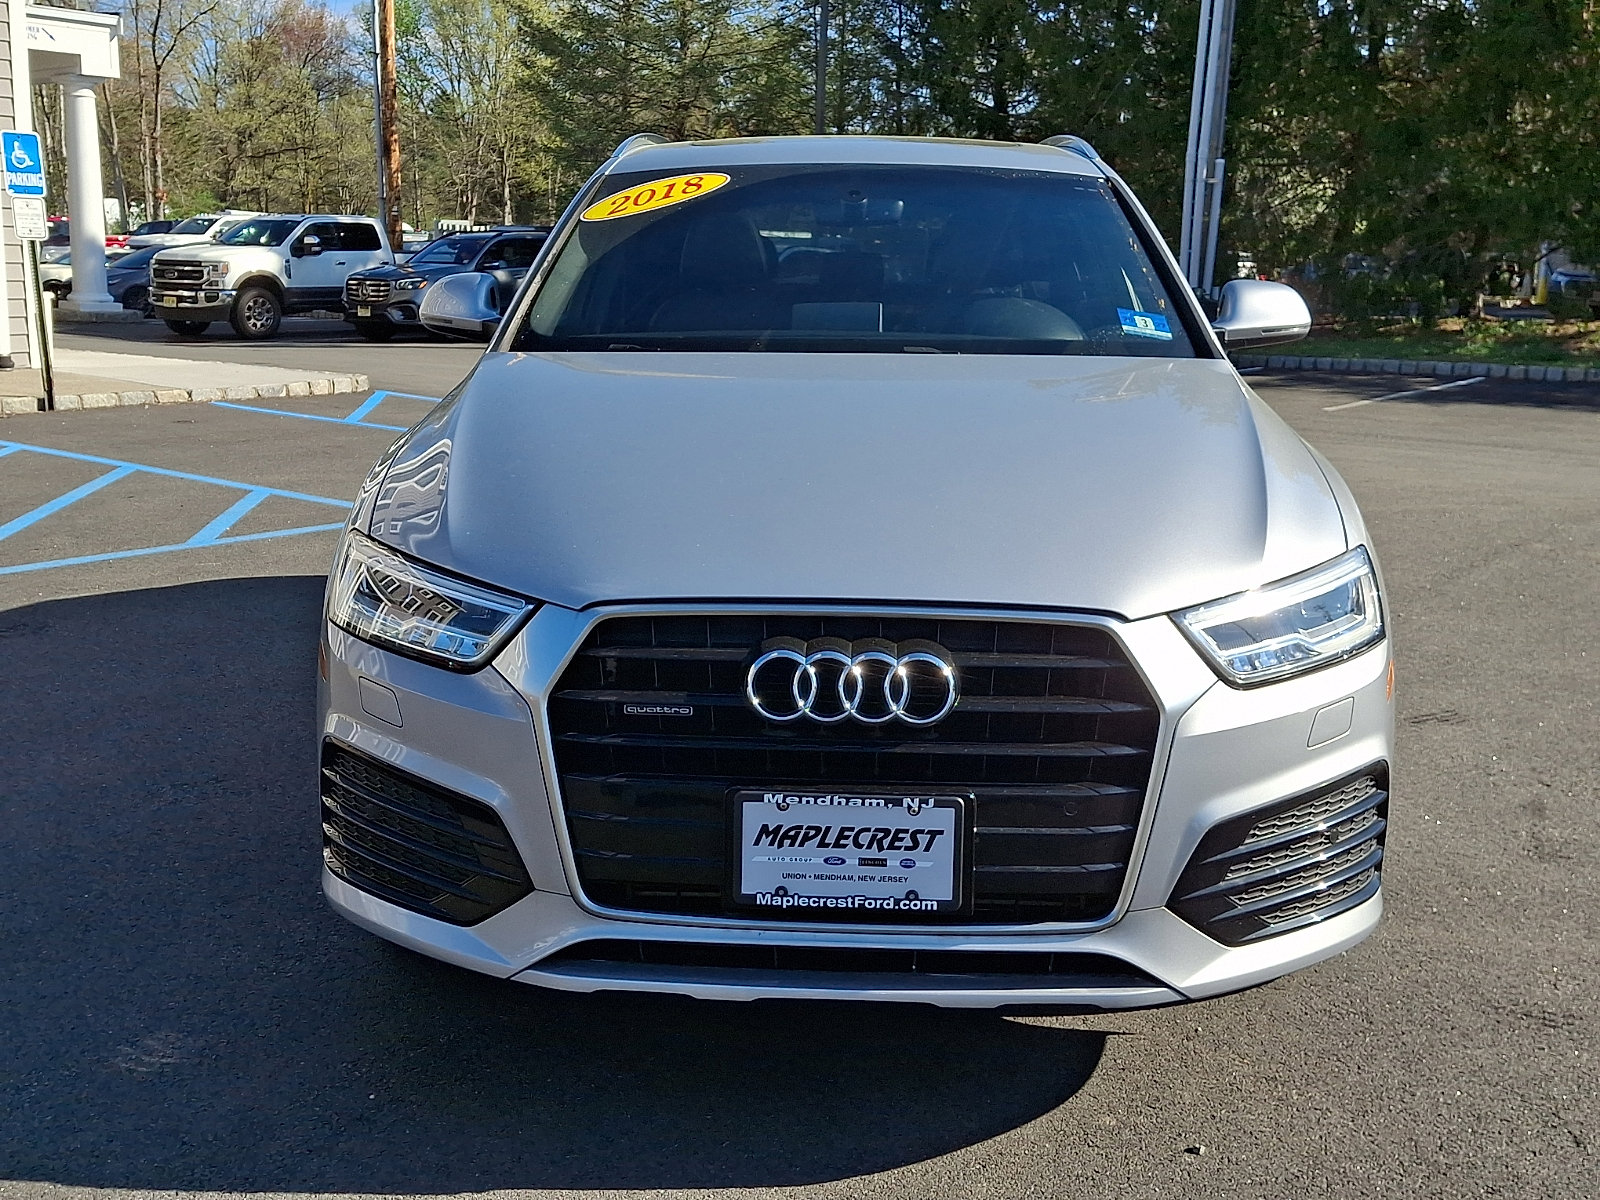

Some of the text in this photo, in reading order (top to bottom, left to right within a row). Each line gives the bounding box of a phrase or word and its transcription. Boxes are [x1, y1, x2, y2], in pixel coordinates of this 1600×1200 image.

[6, 171, 43, 188] PARKING
[607, 176, 704, 216] 2018
[1140, 318, 1149, 328] 3
[627, 706, 690, 714] quattro
[763, 793, 935, 809] Mendham, NJ
[752, 823, 945, 853] MAPLECREST
[781, 872, 909, 884] UNION MENDHAM, NEW JERSEY
[756, 893, 938, 911] MaplecrestFord.com
